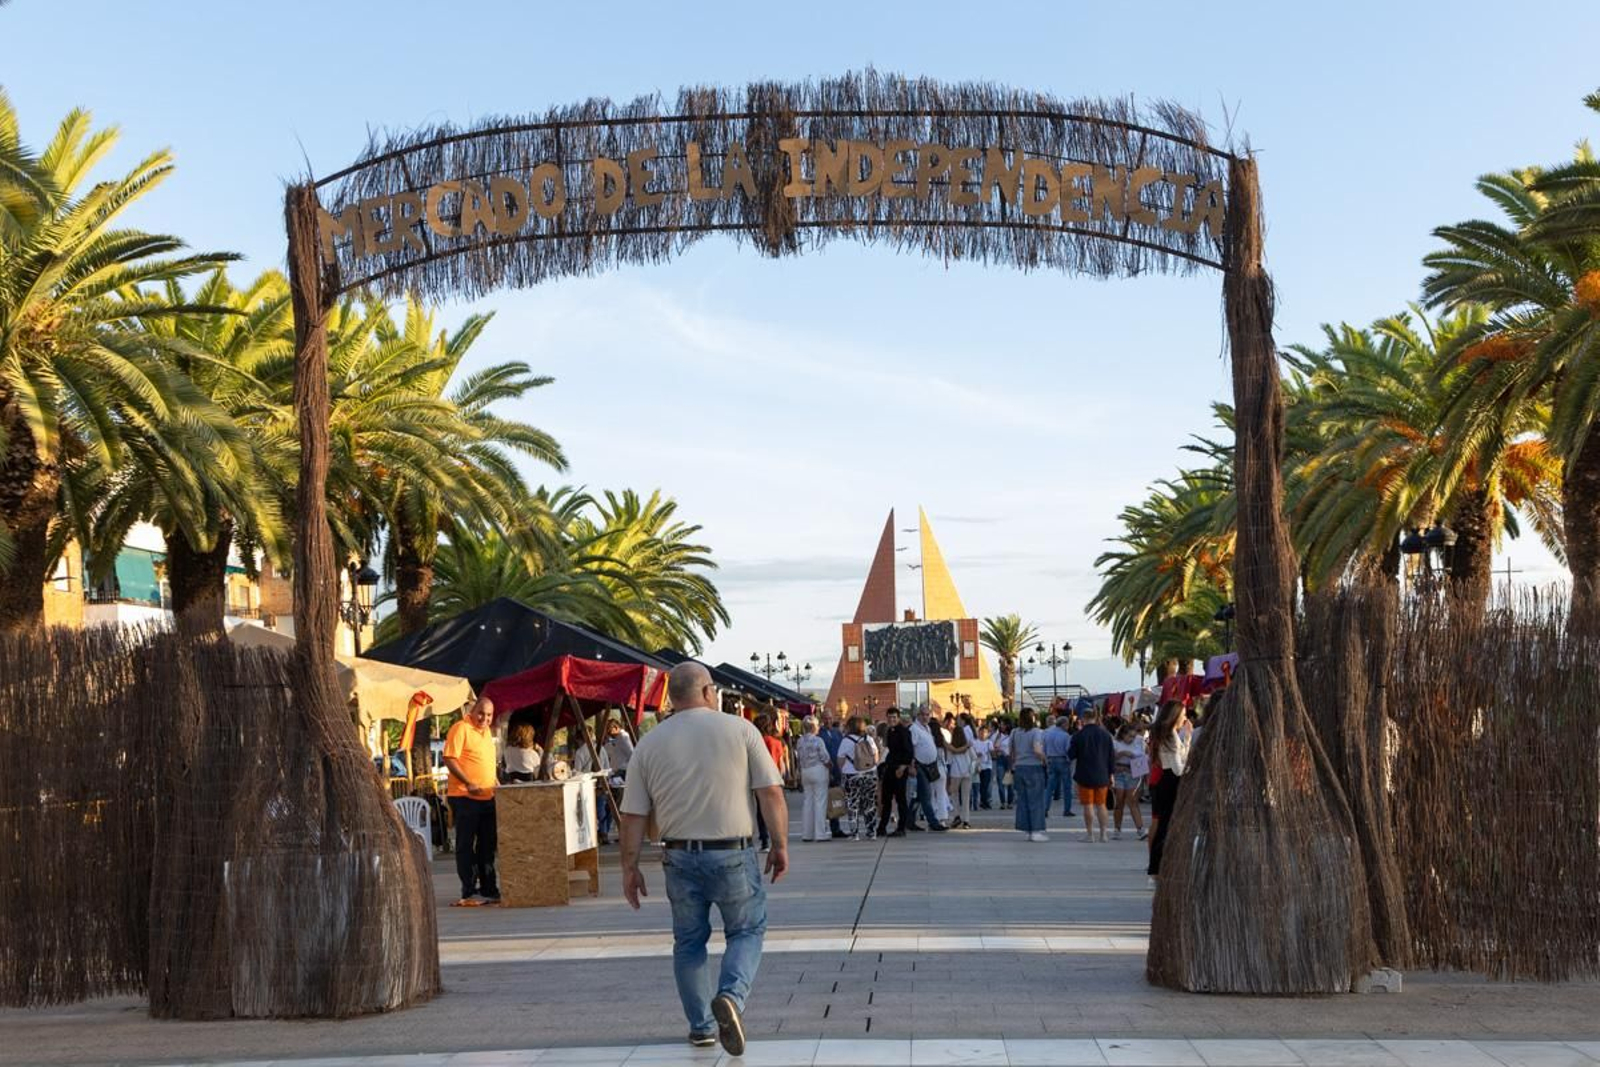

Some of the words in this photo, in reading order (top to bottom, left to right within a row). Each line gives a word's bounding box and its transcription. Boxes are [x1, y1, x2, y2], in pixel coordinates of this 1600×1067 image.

[316, 162, 565, 264] MERCADO
[593, 146, 664, 216] DE
[685, 141, 757, 200] LA
[779, 137, 1225, 237] INDEPENDENCIA
